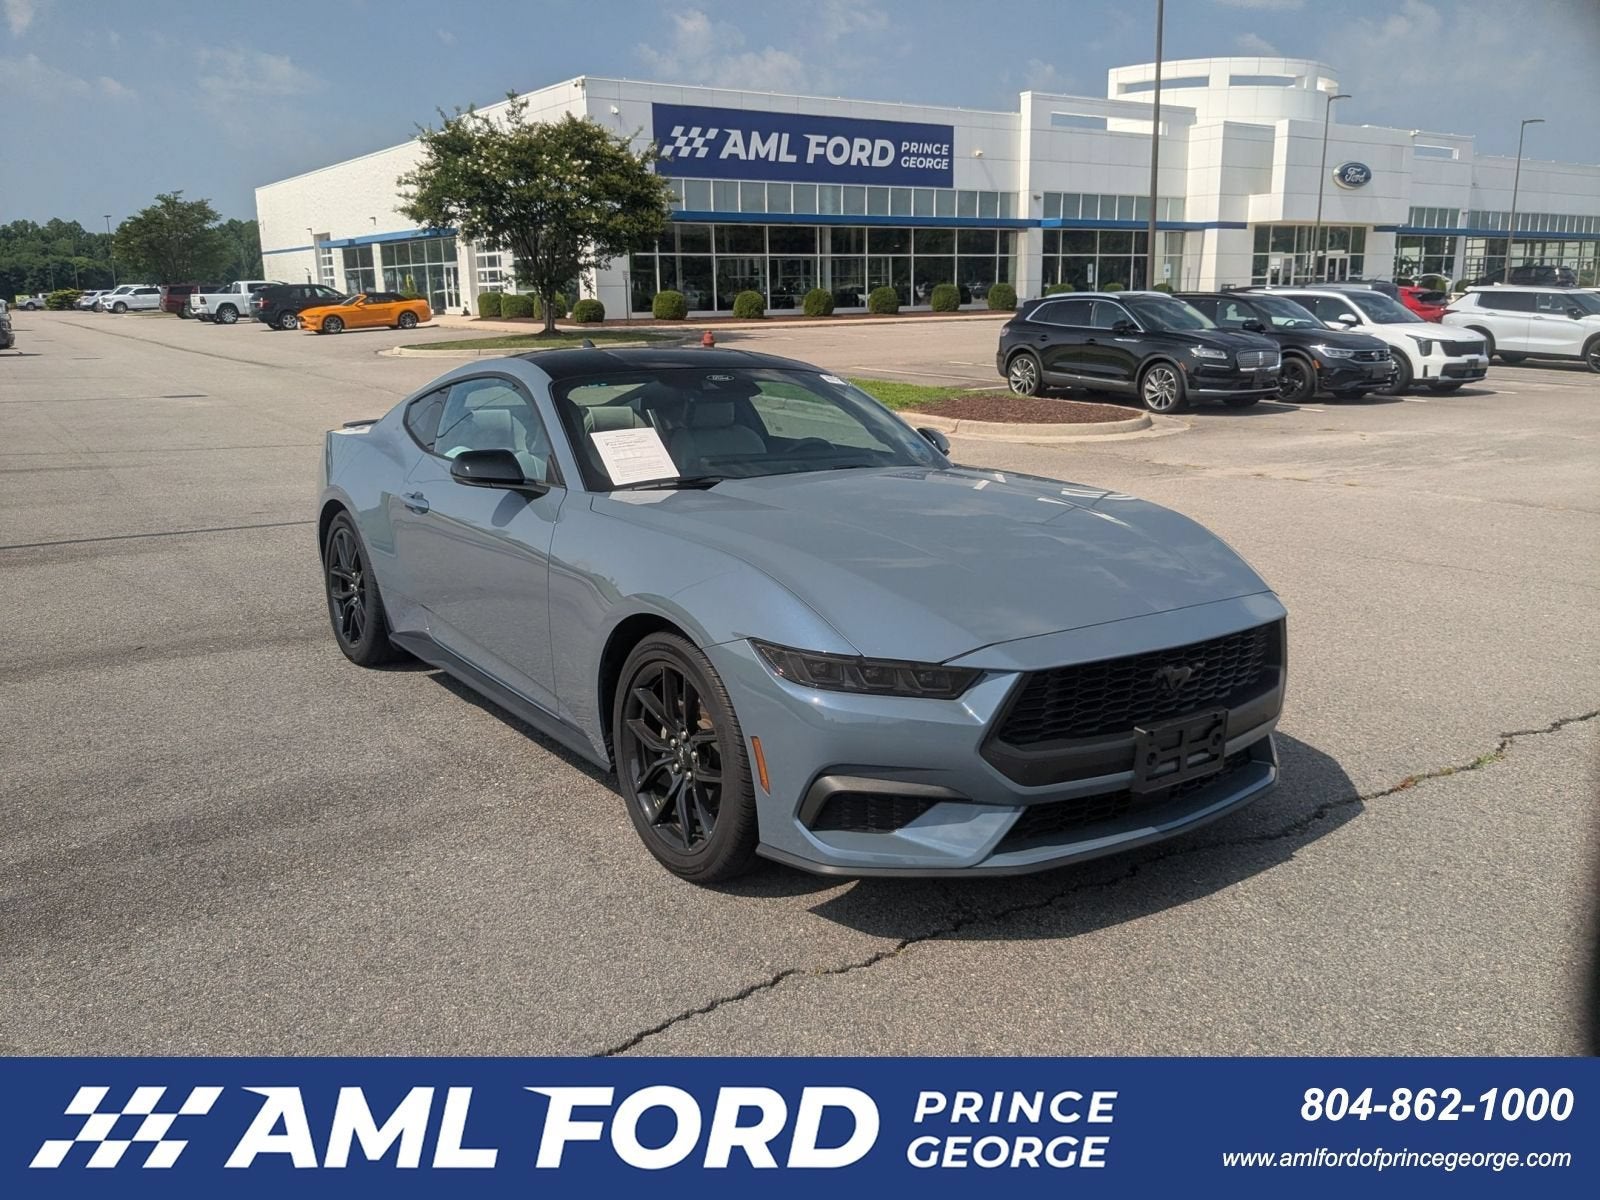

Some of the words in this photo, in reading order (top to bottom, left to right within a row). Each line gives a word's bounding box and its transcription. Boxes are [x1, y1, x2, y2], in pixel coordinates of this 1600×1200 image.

[719, 128, 797, 163] AML
[803, 134, 896, 167] FORD
[901, 141, 950, 156] PRINCE
[900, 156, 950, 170] GEORGE
[1345, 167, 1366, 182] Ford
